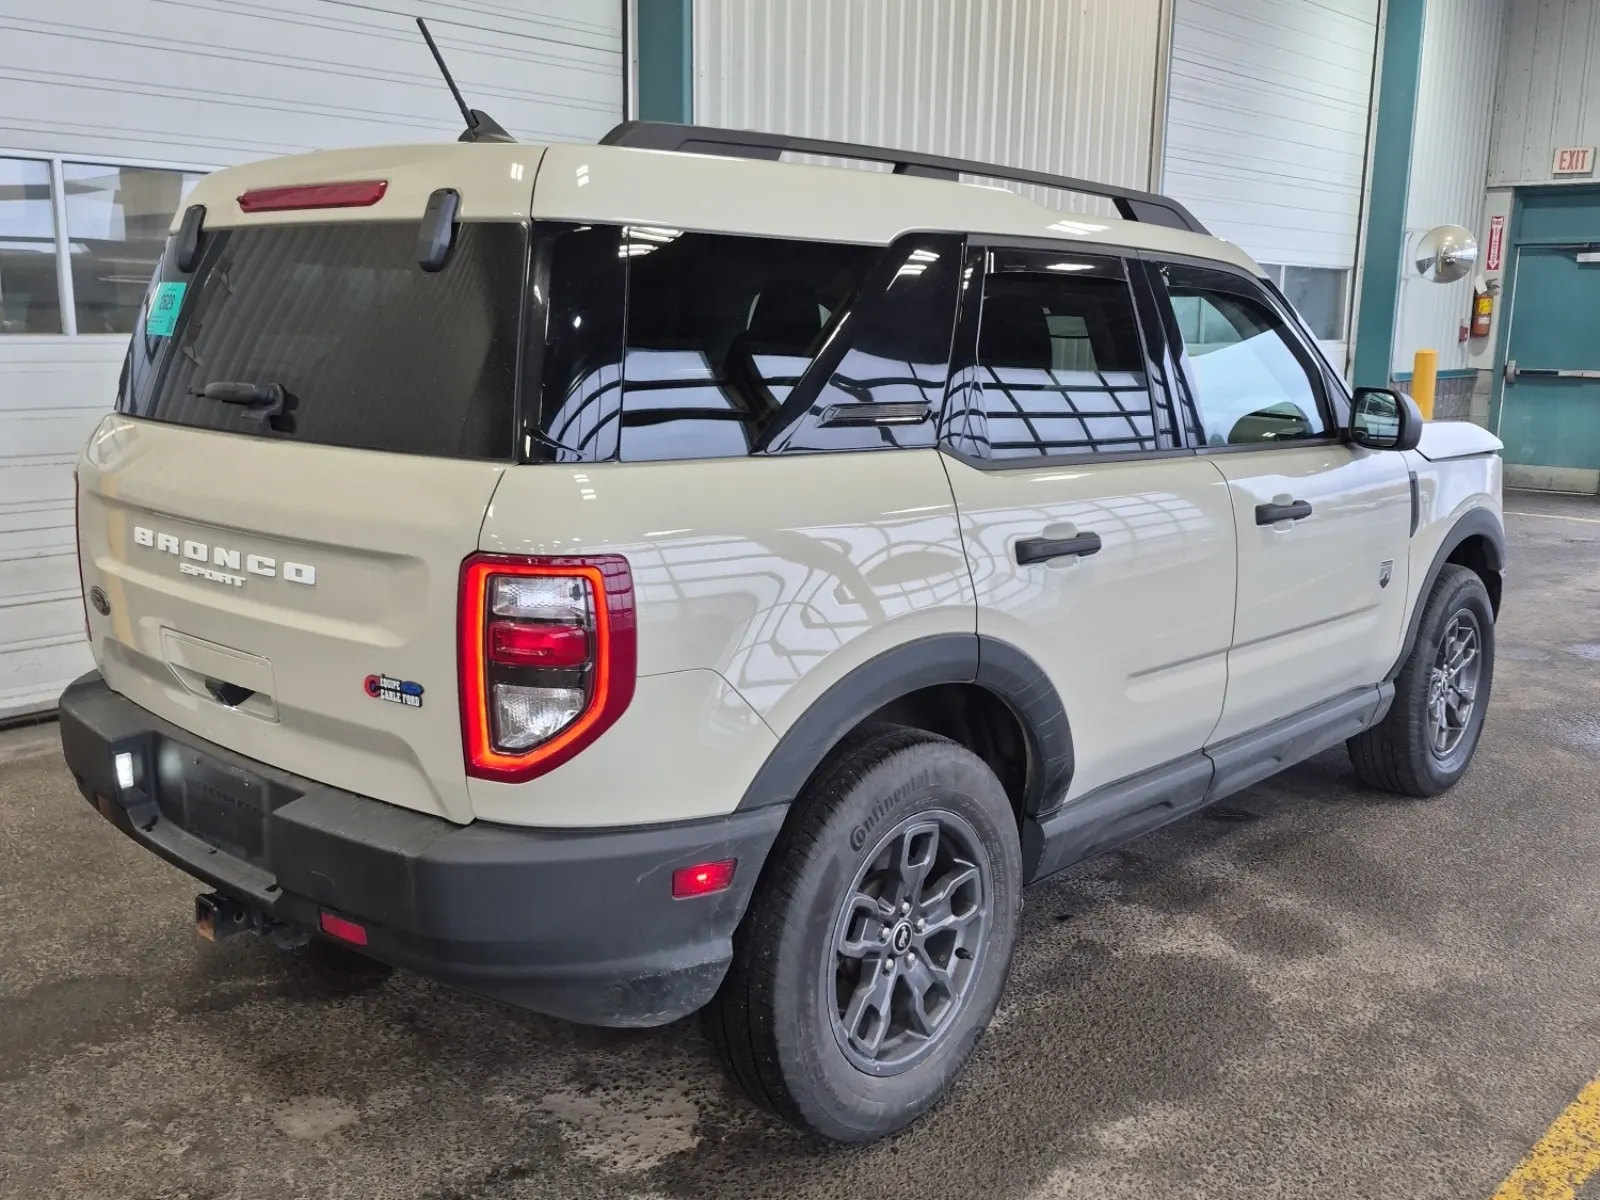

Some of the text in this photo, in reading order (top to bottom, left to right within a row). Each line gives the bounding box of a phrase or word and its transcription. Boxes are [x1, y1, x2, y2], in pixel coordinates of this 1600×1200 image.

[1559, 150, 1589, 170] EXIT
[134, 526, 316, 585] BRONCO
[180, 562, 247, 587] SPORT
[402, 694, 420, 707] FORD
[850, 768, 931, 851] Continental
